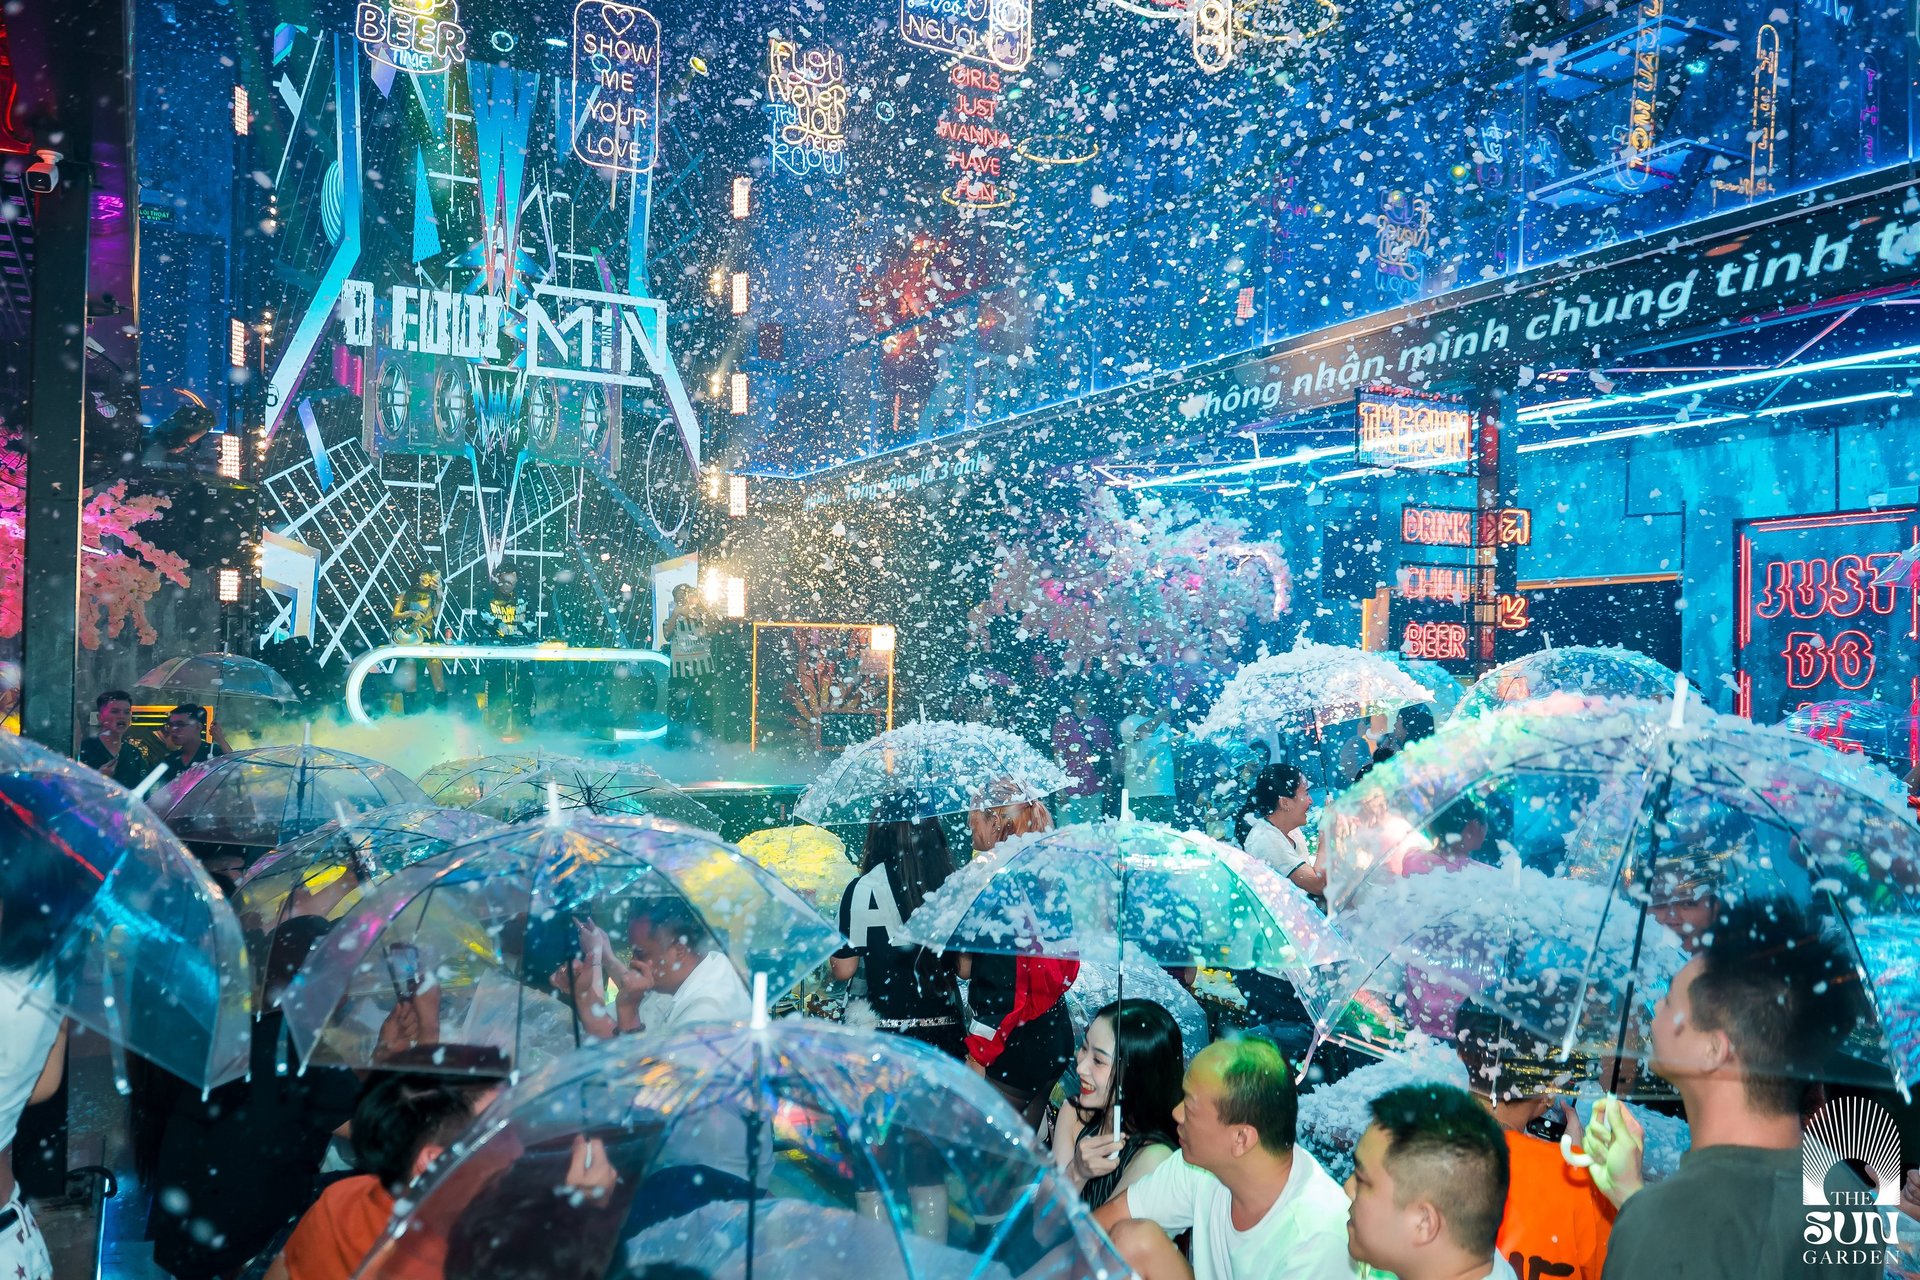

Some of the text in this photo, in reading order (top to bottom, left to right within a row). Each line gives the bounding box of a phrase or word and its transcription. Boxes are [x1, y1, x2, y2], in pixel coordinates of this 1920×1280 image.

[356, 3, 466, 62] BEER
[583, 33, 652, 64] SHOW
[601, 69, 634, 92] ME
[952, 66, 1001, 91] GIRLS
[586, 98, 647, 128] YOUR
[954, 94, 997, 118] JUST
[587, 132, 642, 161] LOVE
[937, 120, 1012, 150] WANNA
[950, 150, 1001, 176] HAVE
[1182, 376, 1282, 419] hông
[1397, 317, 1510, 371] mình
[1525, 279, 1698, 341] chung
[1716, 233, 1850, 297] tình
[1402, 508, 1472, 546] DRINK
[1403, 566, 1471, 601] CHILL
[1756, 552, 1902, 619] JUST
[1404, 622, 1467, 659] BEER
[1781, 630, 1876, 690] DO
